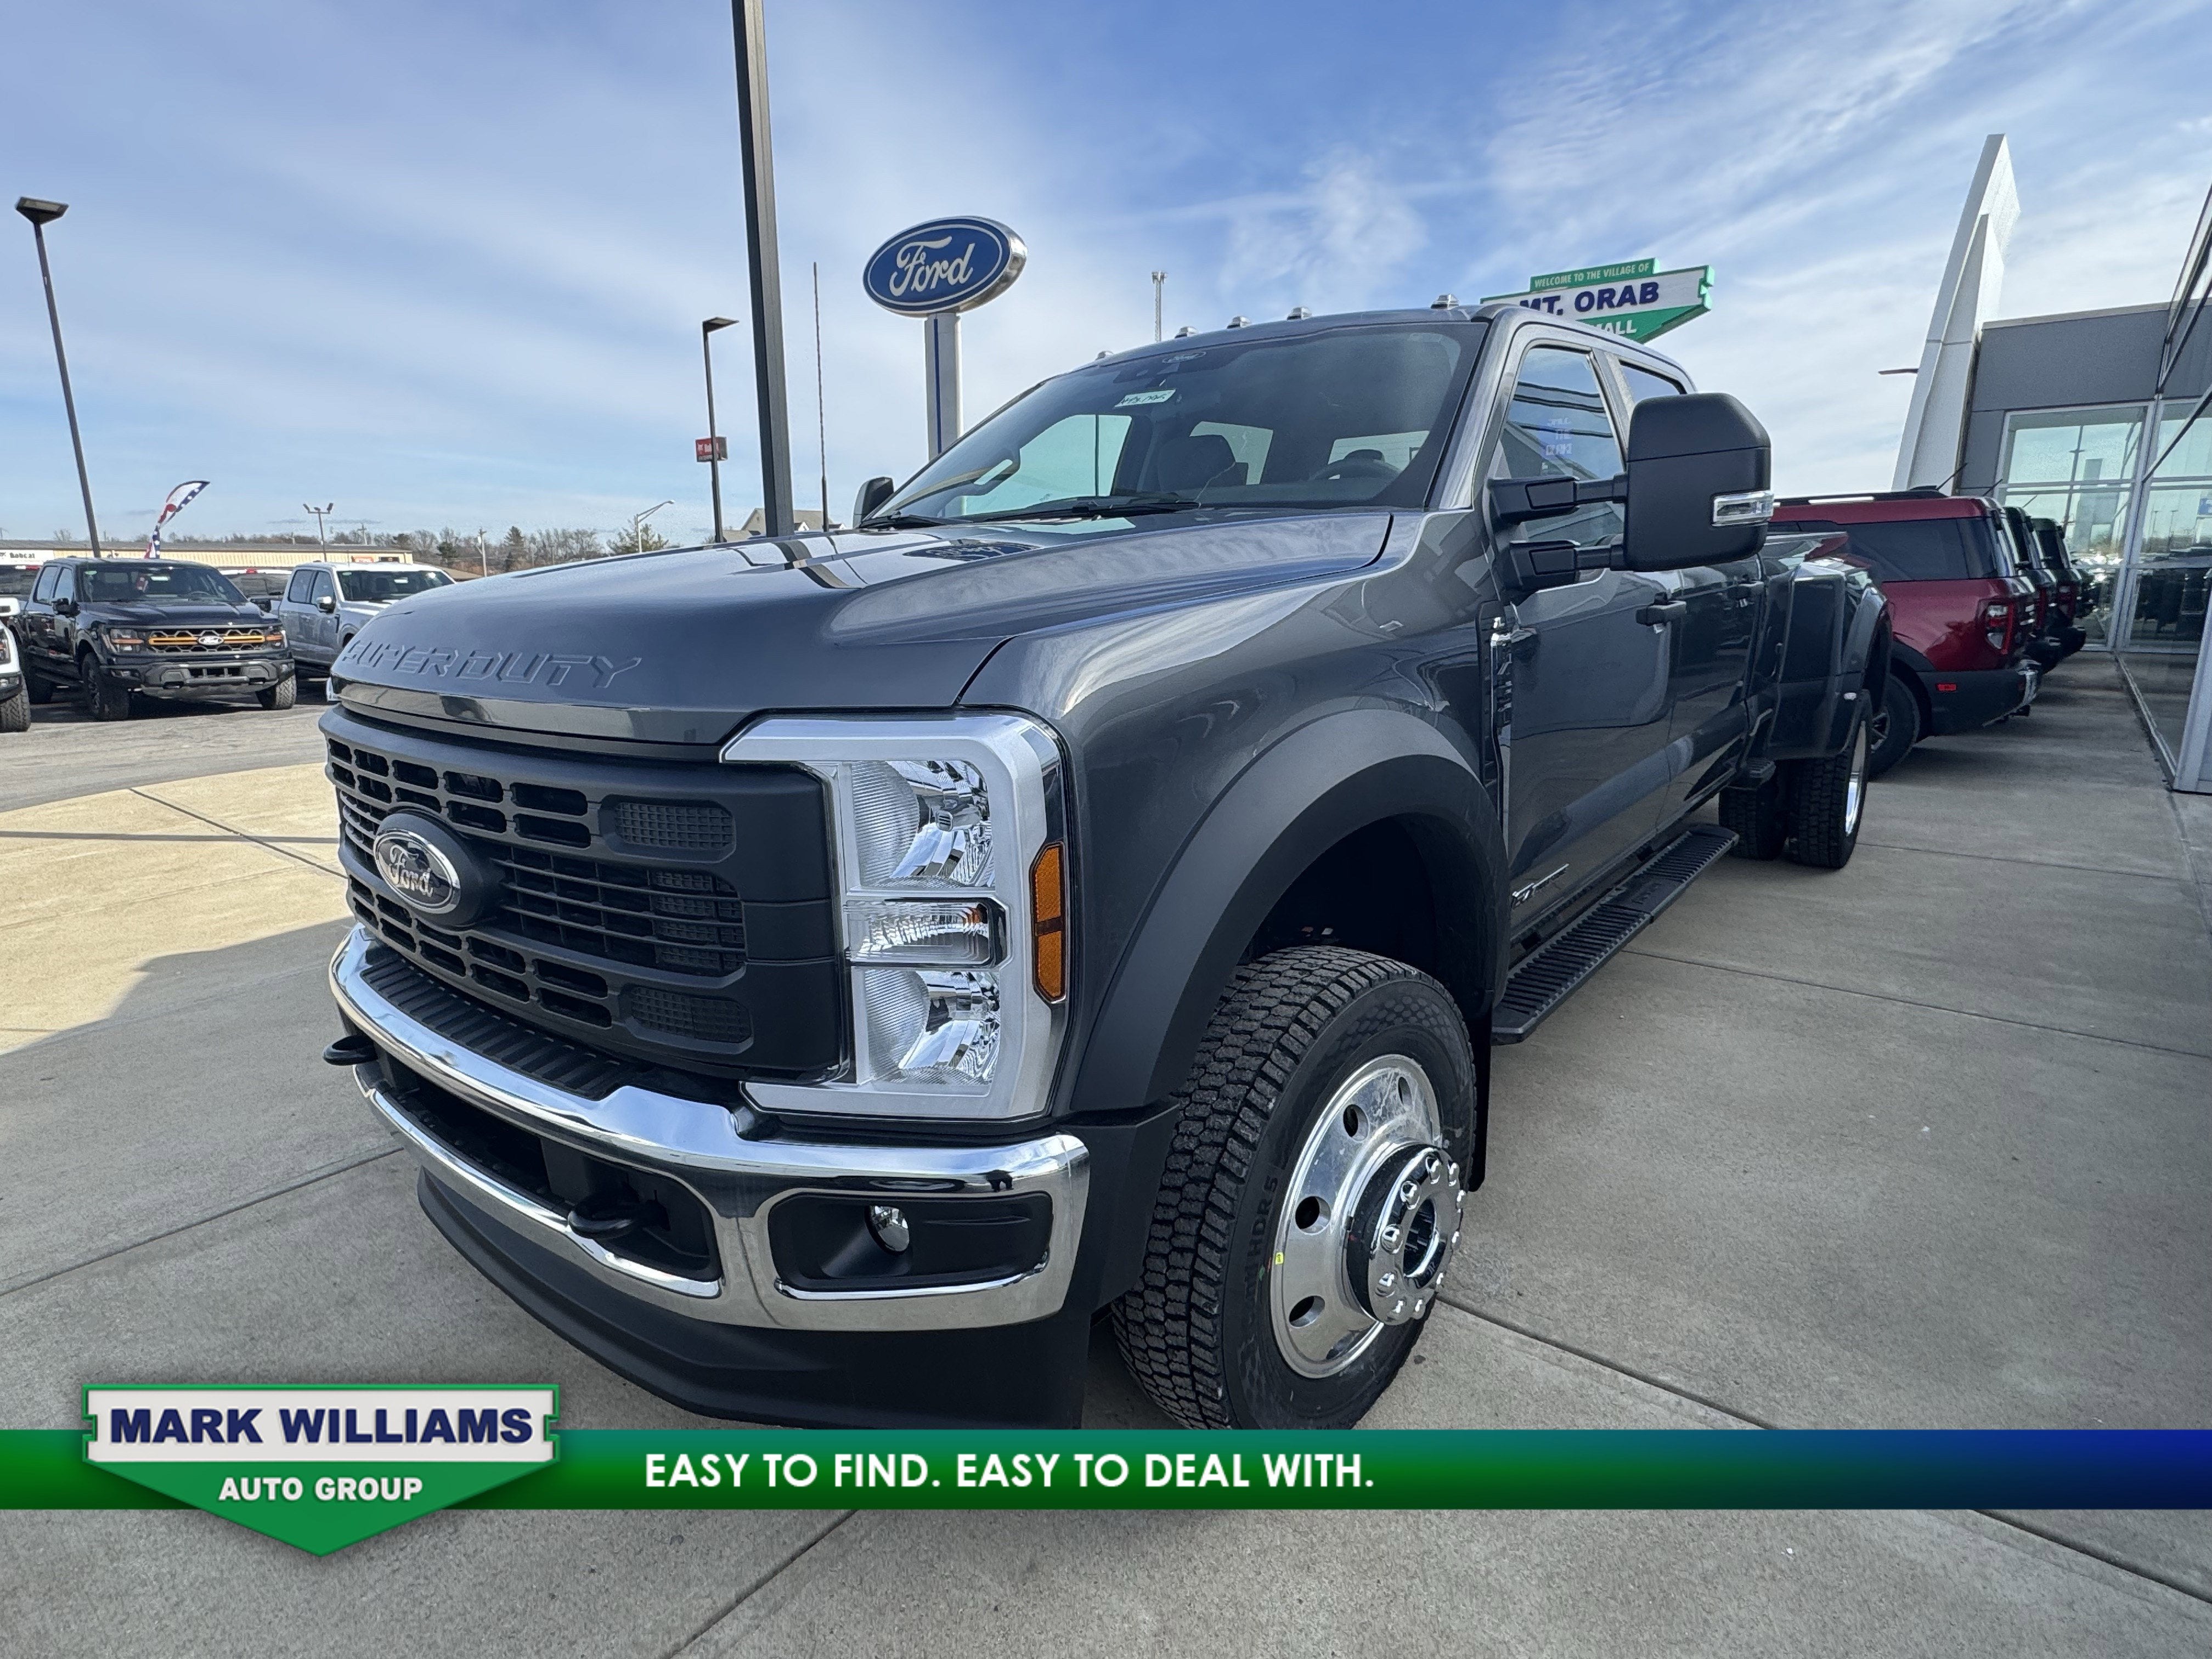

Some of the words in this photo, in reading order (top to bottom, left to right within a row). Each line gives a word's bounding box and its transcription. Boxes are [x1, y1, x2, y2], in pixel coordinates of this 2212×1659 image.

[889, 236, 975, 296] Ford
[1535, 275, 1571, 288] WELCOME
[1574, 273, 1584, 281] TO
[1587, 270, 1601, 280] THE
[1604, 266, 1635, 278] VILLAGE
[1638, 263, 1650, 273] OF
[1574, 281, 1659, 313] ORAB
[1596, 319, 1637, 335] ALL
[341, 640, 460, 677] SUPER
[455, 648, 642, 689] DUTY
[388, 844, 433, 898] Ford
